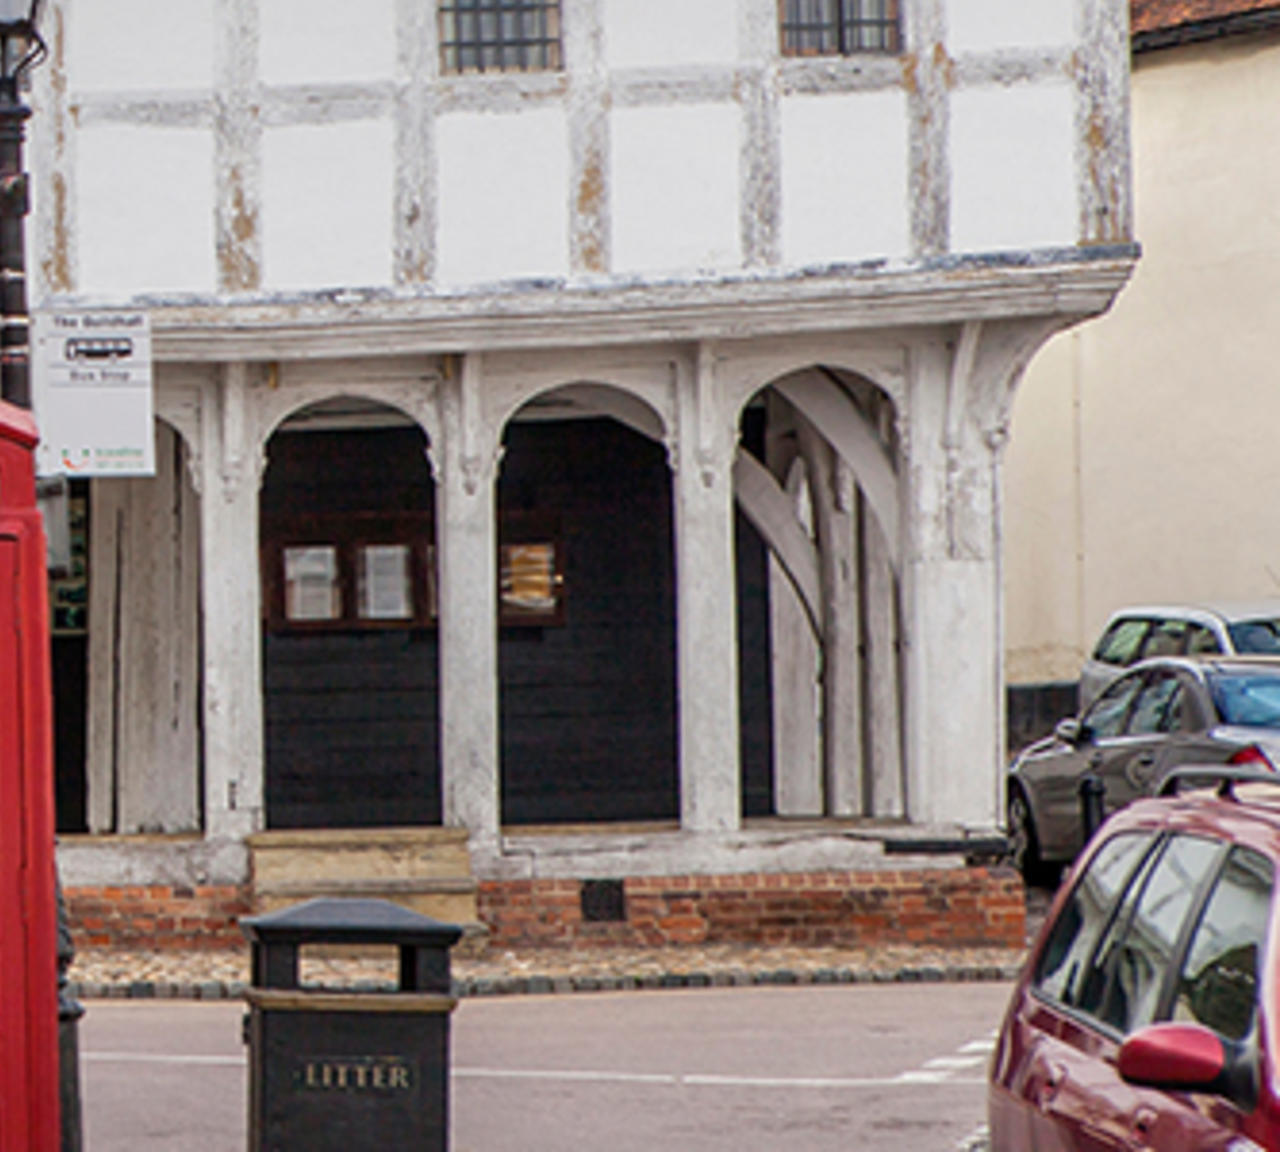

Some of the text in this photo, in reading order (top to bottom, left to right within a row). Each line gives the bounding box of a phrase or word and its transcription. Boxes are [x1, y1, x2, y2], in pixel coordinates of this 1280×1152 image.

[54, 313, 143, 328] The Guildhall
[69, 368, 131, 383] Bus Stop
[306, 1062, 410, 1089] LITTER
